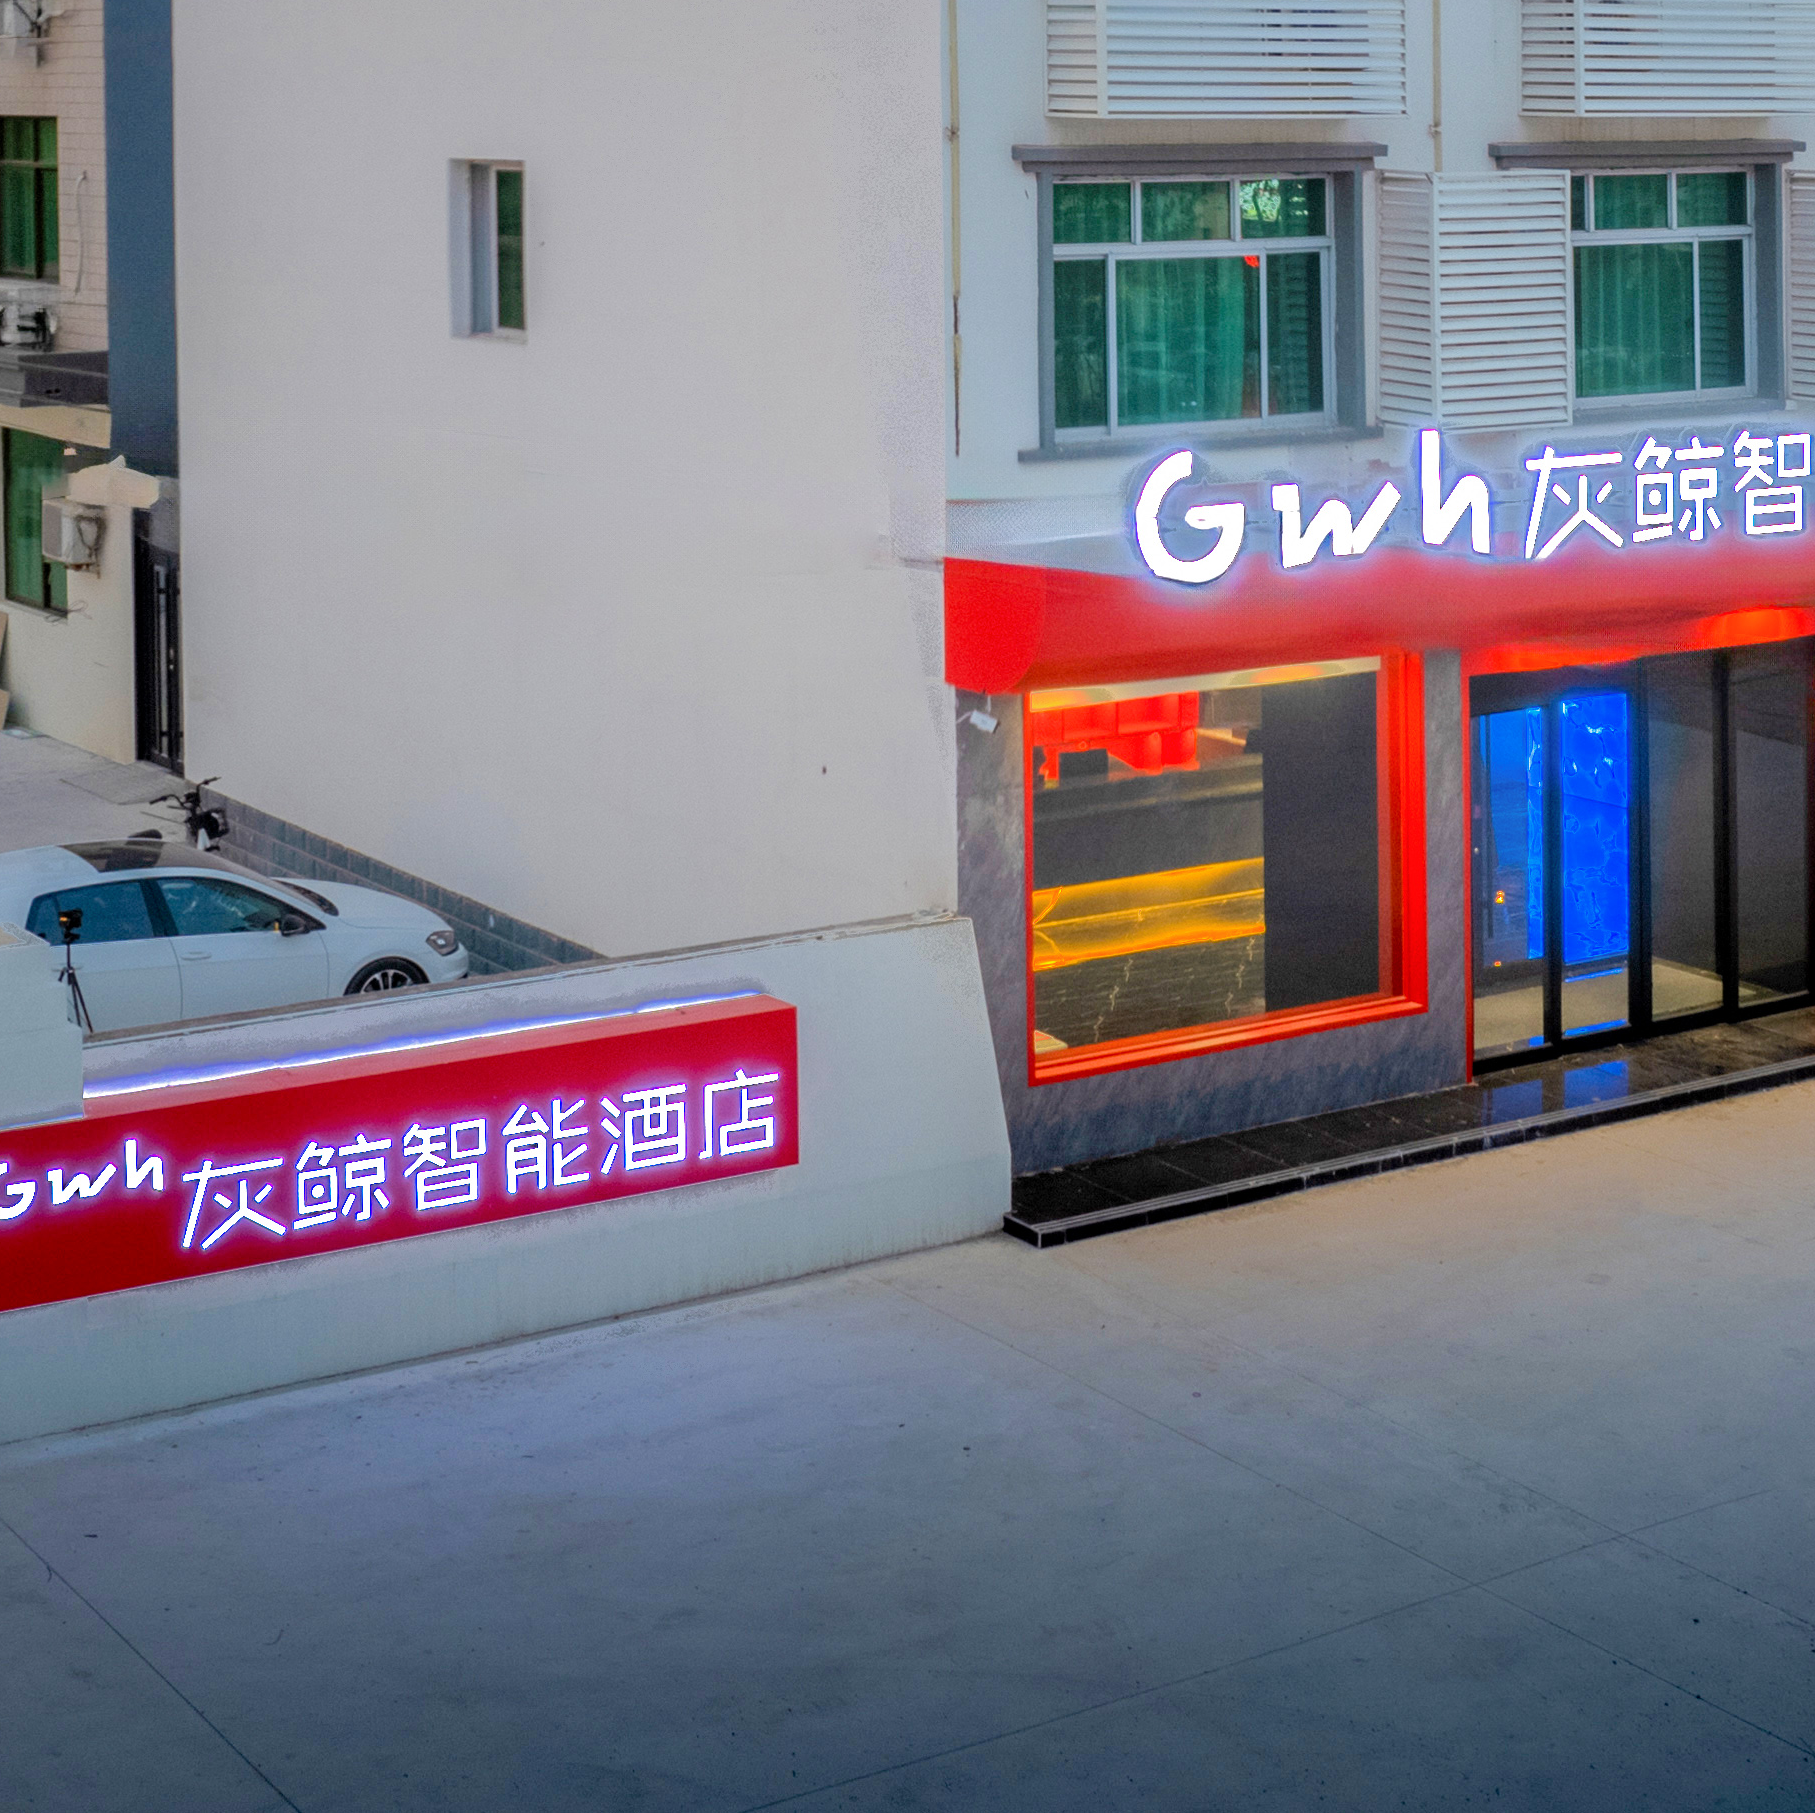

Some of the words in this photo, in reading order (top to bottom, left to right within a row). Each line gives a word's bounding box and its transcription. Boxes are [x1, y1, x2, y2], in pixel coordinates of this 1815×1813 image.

[1133, 428, 1492, 585] Gwh
[181, 1068, 780, 1251] 灰鲸智能酒店
